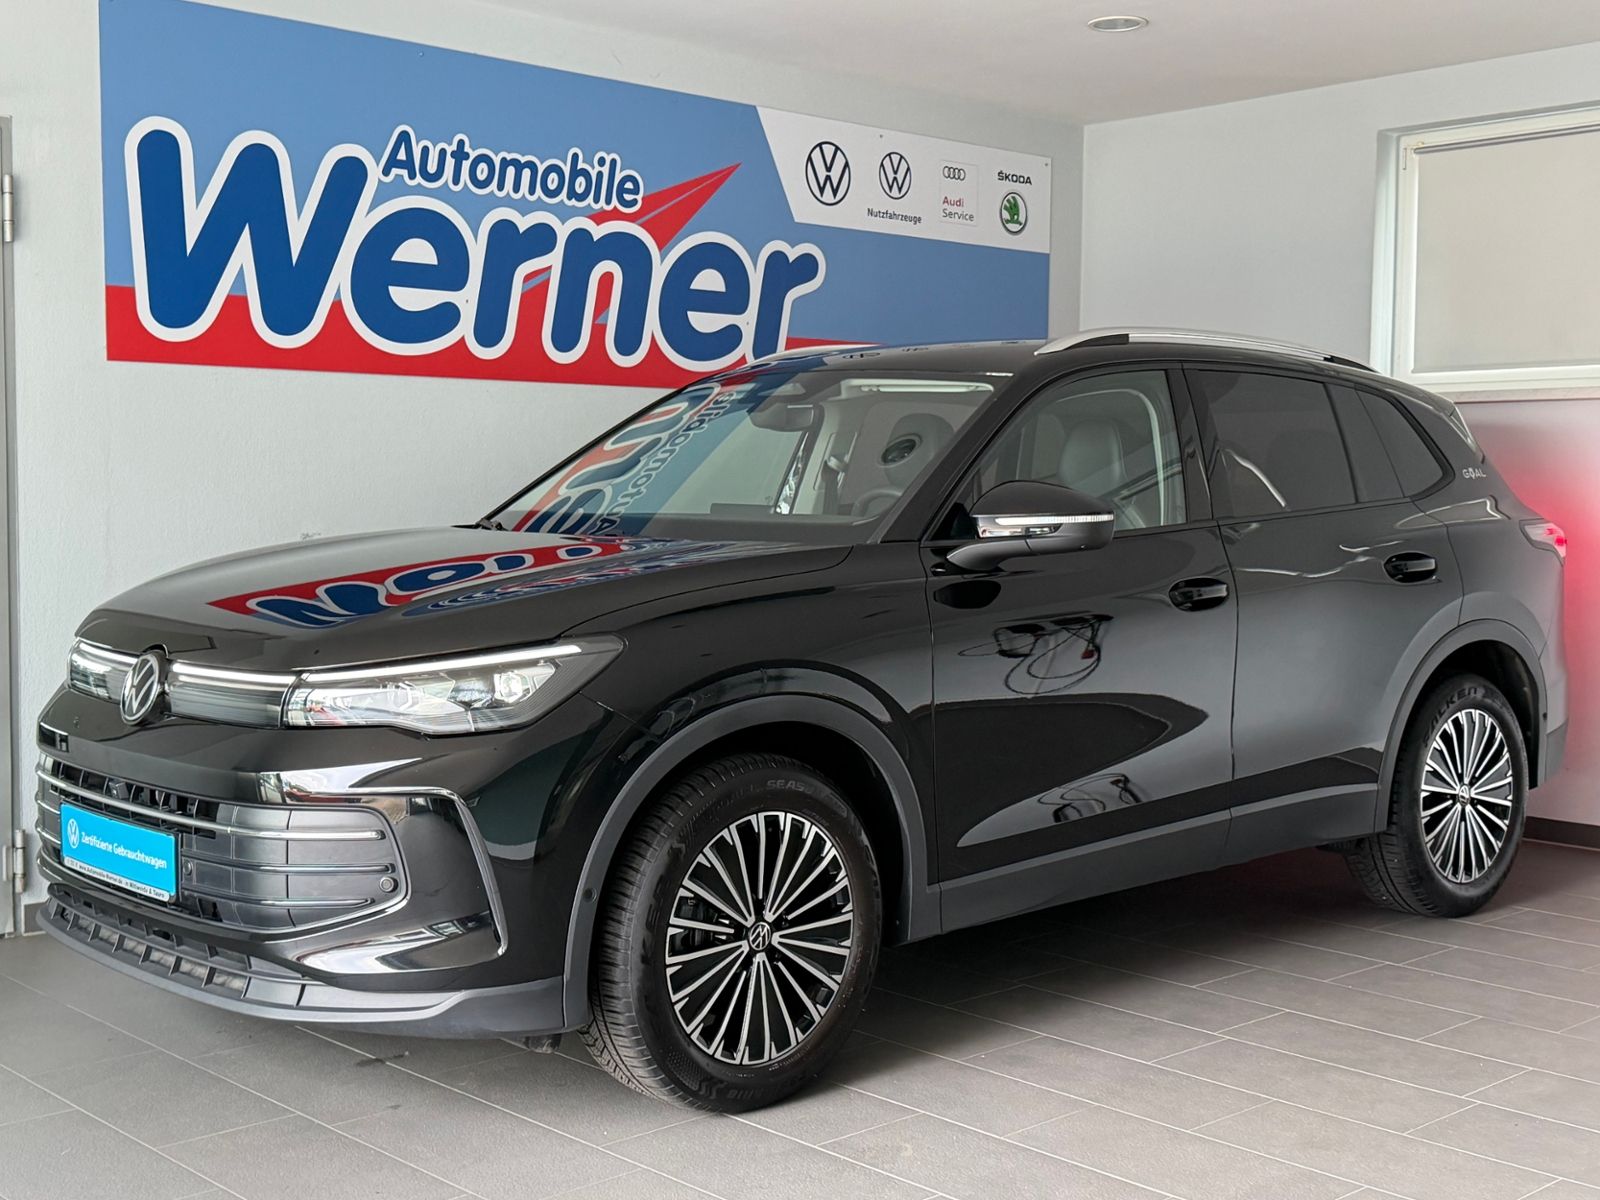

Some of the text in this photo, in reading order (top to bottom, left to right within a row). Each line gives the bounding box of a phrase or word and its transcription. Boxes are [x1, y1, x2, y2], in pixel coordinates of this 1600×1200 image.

[381, 127, 642, 210] Automobile
[997, 170, 1033, 186] ŠKODA
[942, 195, 964, 208] Audi
[867, 207, 923, 225] Nutzfahrzeuge
[942, 207, 975, 222] Service
[134, 126, 822, 364] Werner
[81, 832, 167, 869] Zertifizierte Gebrauchtwagen
